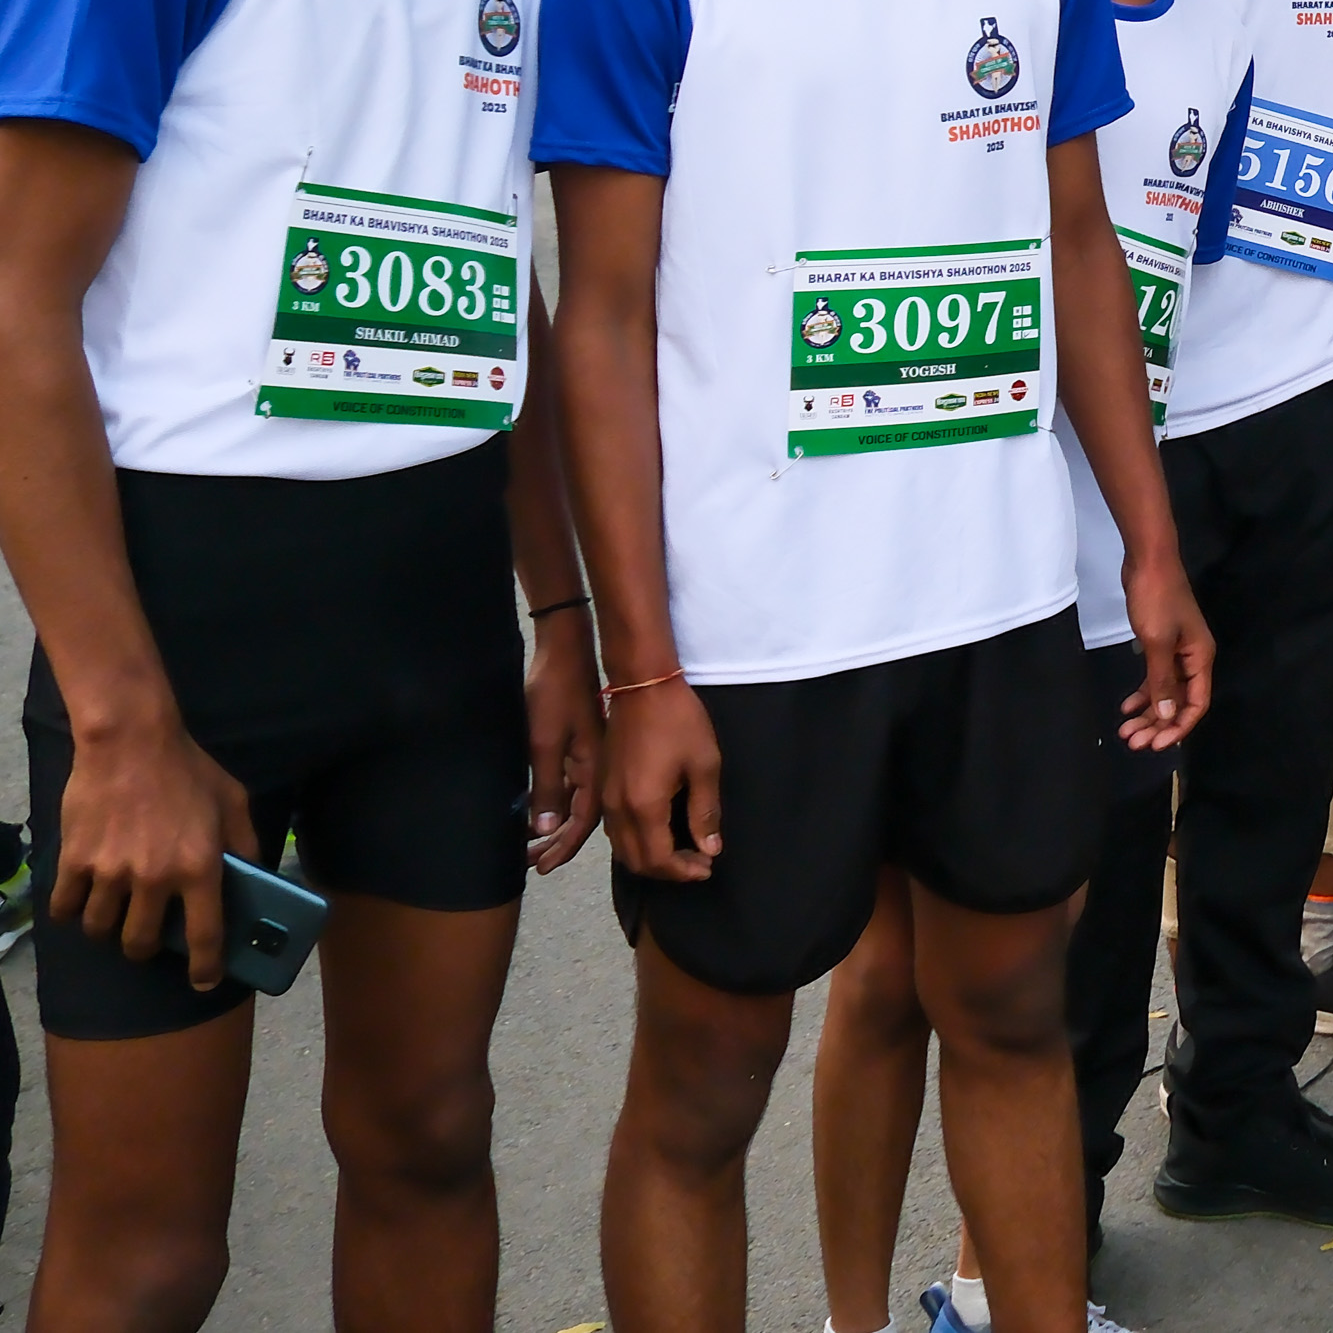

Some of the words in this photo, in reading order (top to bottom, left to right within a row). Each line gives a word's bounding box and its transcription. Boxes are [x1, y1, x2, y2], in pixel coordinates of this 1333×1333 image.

[482, 102, 506, 113] 2025
[941, 108, 980, 122] BHARAT
[982, 106, 992, 116] KA
[1252, 117, 1263, 127] KA
[1266, 121, 1311, 140] BHAVISHYA
[987, 141, 1004, 152] 2025
[1260, 199, 1305, 218] ABHISHEK
[303, 209, 347, 225] BHARAT
[350, 215, 364, 228] KA
[368, 218, 429, 235] BHAVISHYA
[432, 226, 488, 244] SHAHOTHON
[490, 236, 508, 248] 2025
[1245, 246, 1255, 257] OF
[1257, 252, 1317, 273] CONSTITUTION
[808, 272, 856, 284] BHARAT
[860, 271, 876, 282] KA
[880, 268, 944, 281] BHAVISHYA
[946, 264, 1007, 277] SHAHOTHON
[1009, 262, 1031, 273] 2025
[336, 246, 487, 320] 3083
[301, 301, 320, 312] KM
[850, 291, 1007, 354] 3097
[355, 327, 408, 343] SHAKIL
[410, 334, 460, 348] AHMAD
[806, 355, 813, 363] 3
[815, 354, 834, 363] KM
[900, 364, 957, 378] YOGESH
[333, 402, 368, 414] VOICE
[370, 403, 383, 414] OF
[386, 404, 465, 419] CONSTITUTION
[858, 434, 892, 445] VOICE
[895, 433, 908, 443] OF
[911, 425, 988, 440] CONSTITUTION
